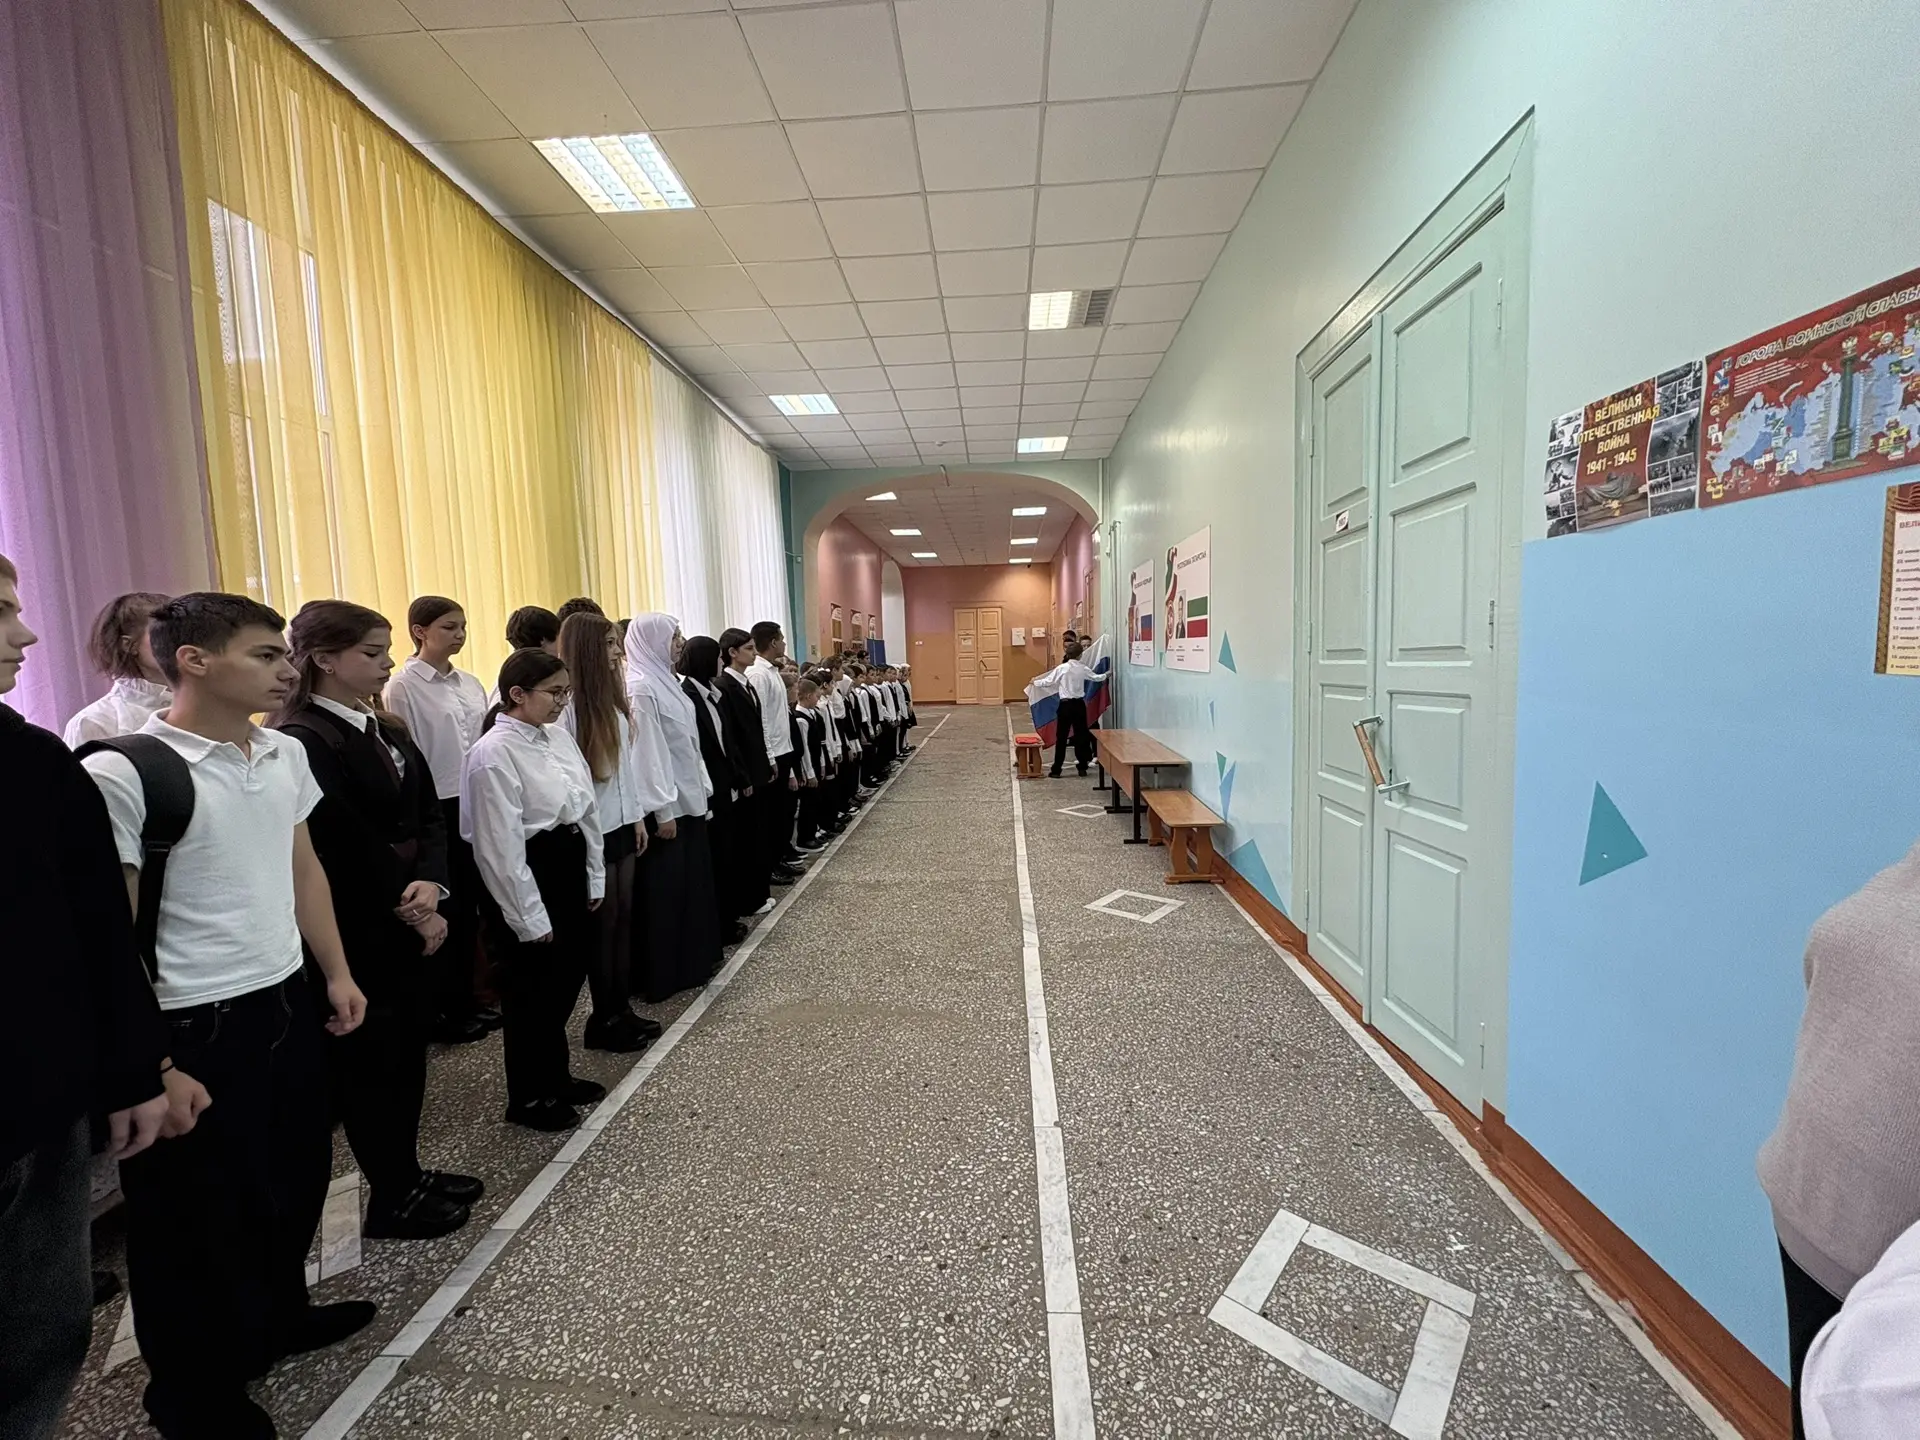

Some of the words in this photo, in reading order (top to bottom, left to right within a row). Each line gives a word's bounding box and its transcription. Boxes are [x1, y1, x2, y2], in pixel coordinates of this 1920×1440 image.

[1735, 338, 1784, 369] ГОРОДА
[1785, 303, 1867, 350] ВОИНСКОЙ
[1595, 393, 1642, 422] ВЕЛИКАЯ
[1577, 404, 1660, 444] ОТЕЧЕСТВЕННАЯ
[1597, 432, 1630, 454] ВОЙНА
[1586, 457, 1607, 475] 1941
[1613, 448, 1638, 467] 1945
